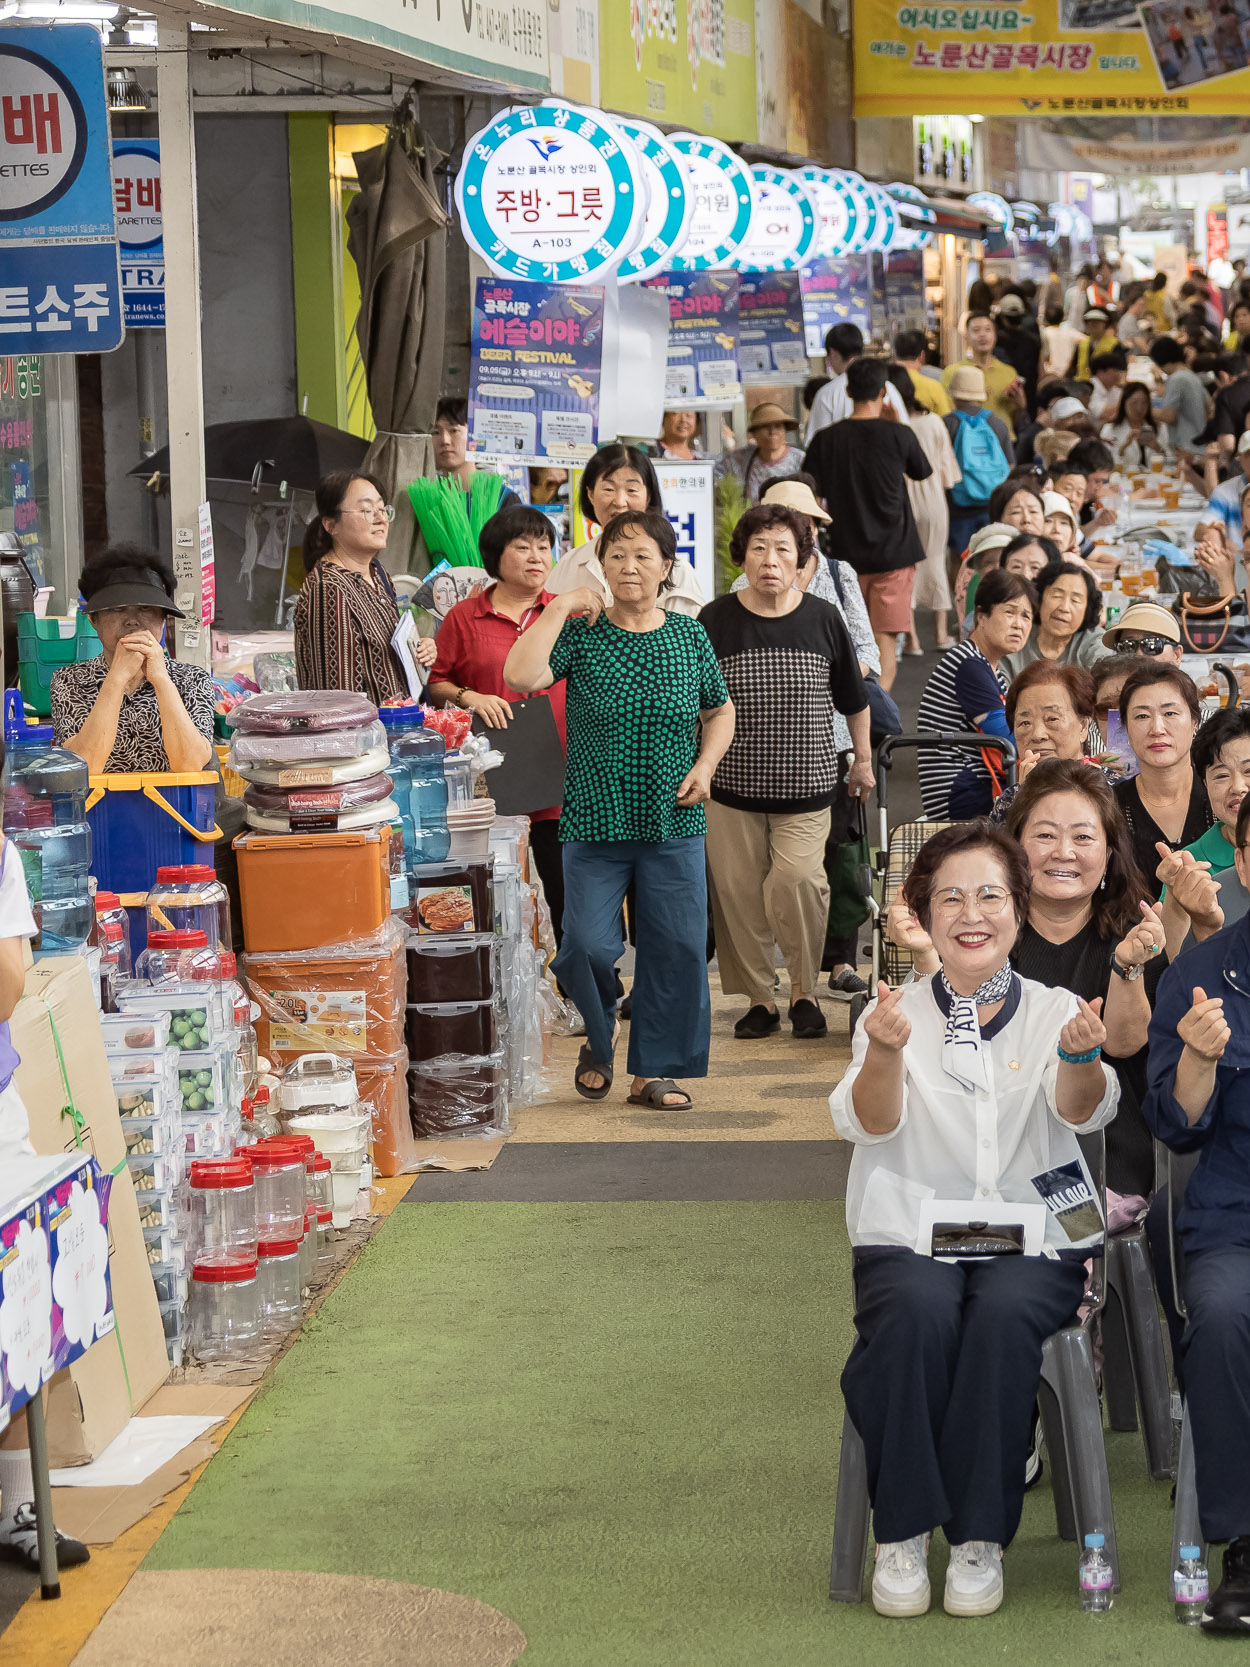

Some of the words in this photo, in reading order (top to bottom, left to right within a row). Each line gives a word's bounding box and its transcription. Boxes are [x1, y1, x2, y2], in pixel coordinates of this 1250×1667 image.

[912, 42, 1093, 70] 노룬산골목시장
[496, 187, 603, 223] 주방·그릇
[532, 238, 572, 248] A-103
[484, 299, 531, 316] 골목시장
[480, 317, 580, 345] 예술이야
[480, 348, 512, 361] BEER
[515, 349, 576, 364] FESTIVAL
